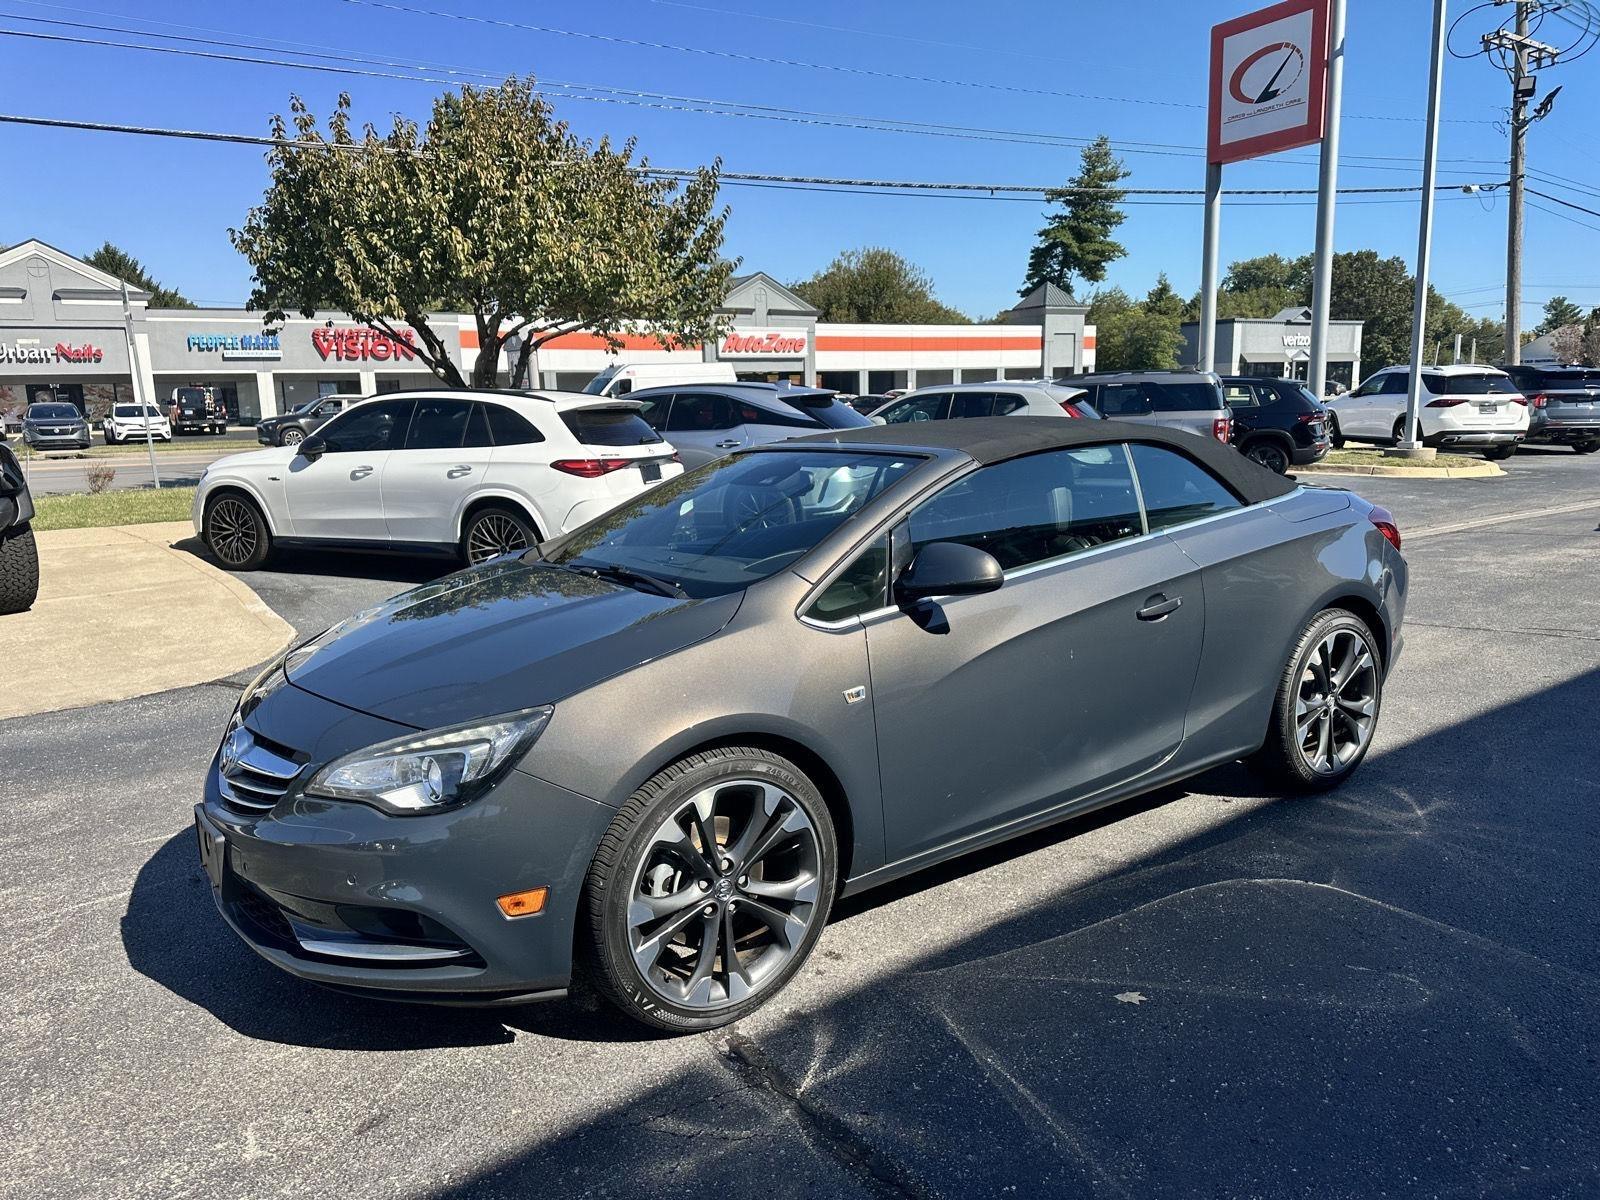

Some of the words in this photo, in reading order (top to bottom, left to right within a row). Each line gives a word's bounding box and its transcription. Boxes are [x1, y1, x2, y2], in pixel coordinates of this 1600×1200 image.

[335, 328, 413, 338] MATTHS
[1282, 332, 1311, 346] verizo
[188, 335, 239, 349] PEOPLE
[312, 339, 416, 360] VISION
[721, 333, 806, 353] AutoZone
[56, 342, 104, 361] Nails
